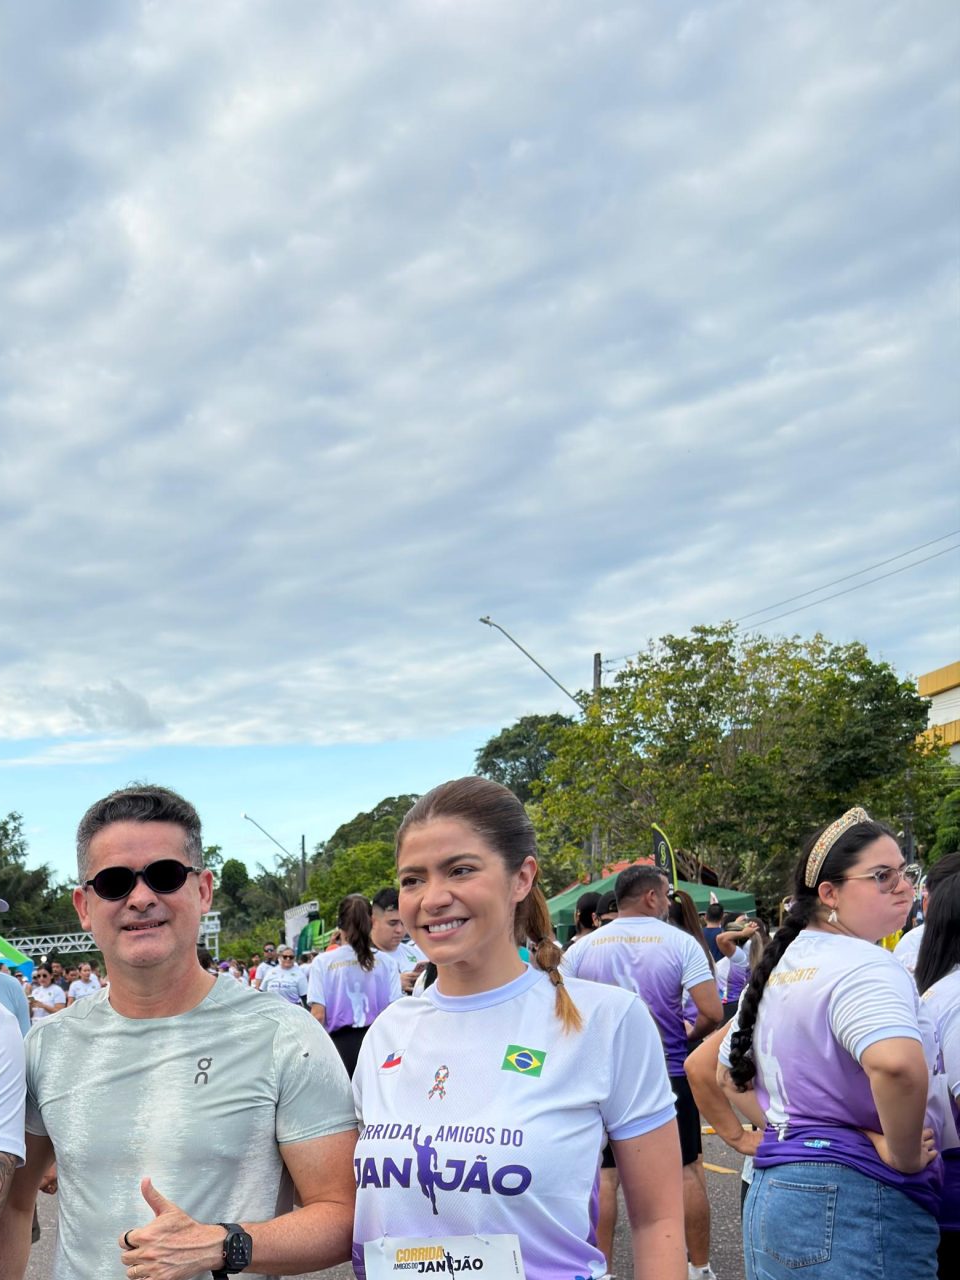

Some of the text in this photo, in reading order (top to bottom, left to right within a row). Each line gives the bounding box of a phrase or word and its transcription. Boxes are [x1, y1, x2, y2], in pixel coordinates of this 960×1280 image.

[361, 1124, 524, 1147] RRIDA AMIGOS DO
[396, 1246, 444, 1263] CORRIDA
